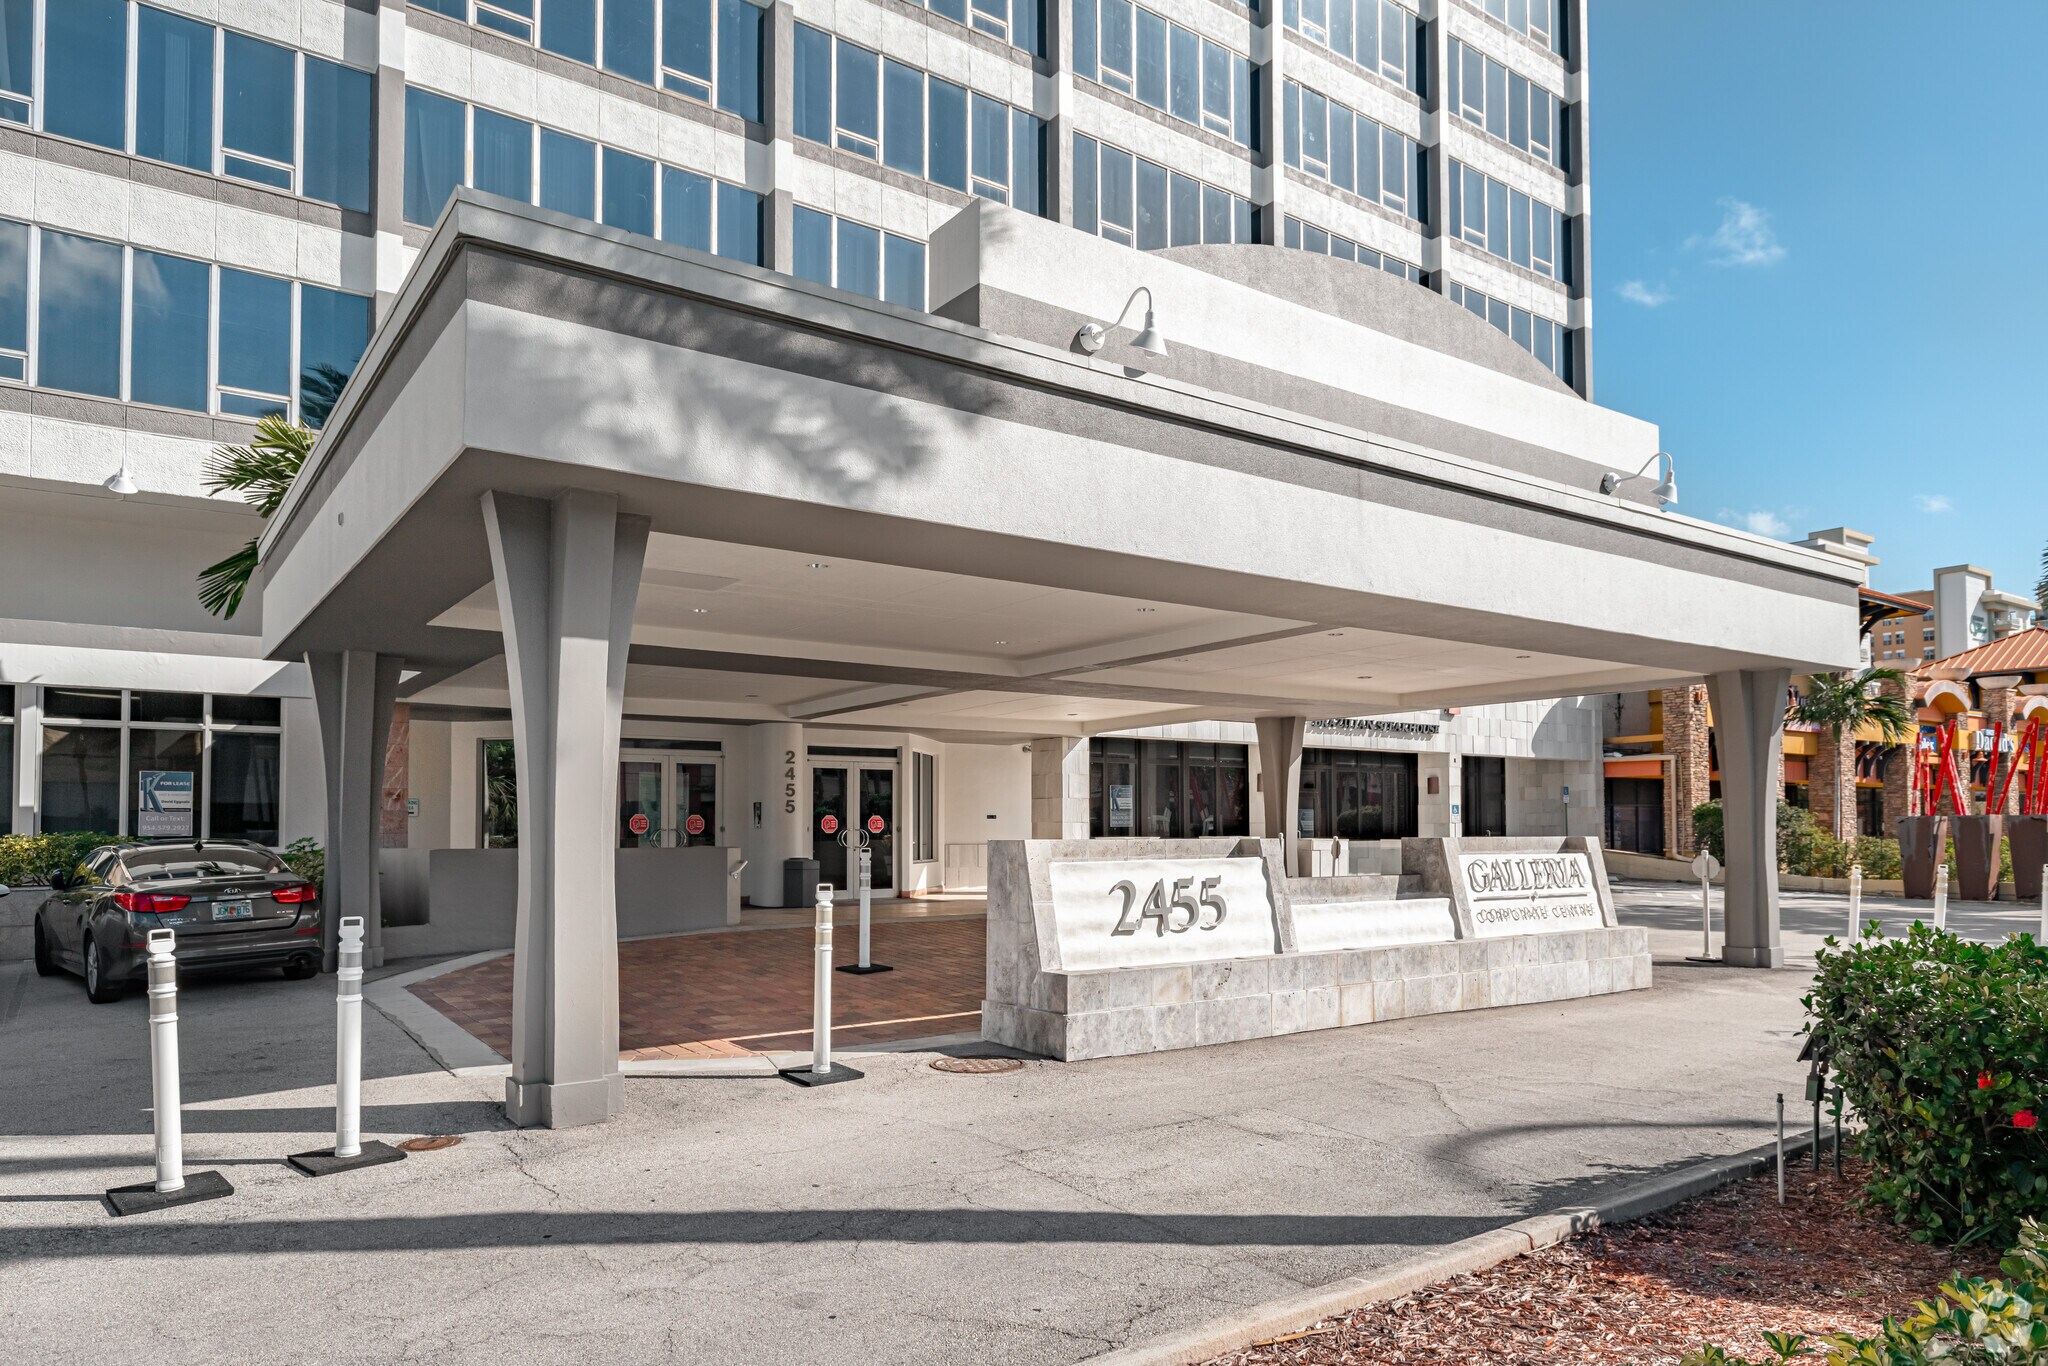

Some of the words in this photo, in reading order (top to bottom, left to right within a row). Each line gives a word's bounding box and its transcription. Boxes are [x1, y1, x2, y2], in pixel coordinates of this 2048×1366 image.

[1375, 720, 1439, 734] STEAKHOUSE
[785, 750, 796, 814] 2455
[1467, 857, 1587, 893] GALLERIA
[1108, 875, 1227, 937] 2455
[1476, 905, 1549, 924] CORPORATE
[1551, 902, 1594, 919] CENTRE
